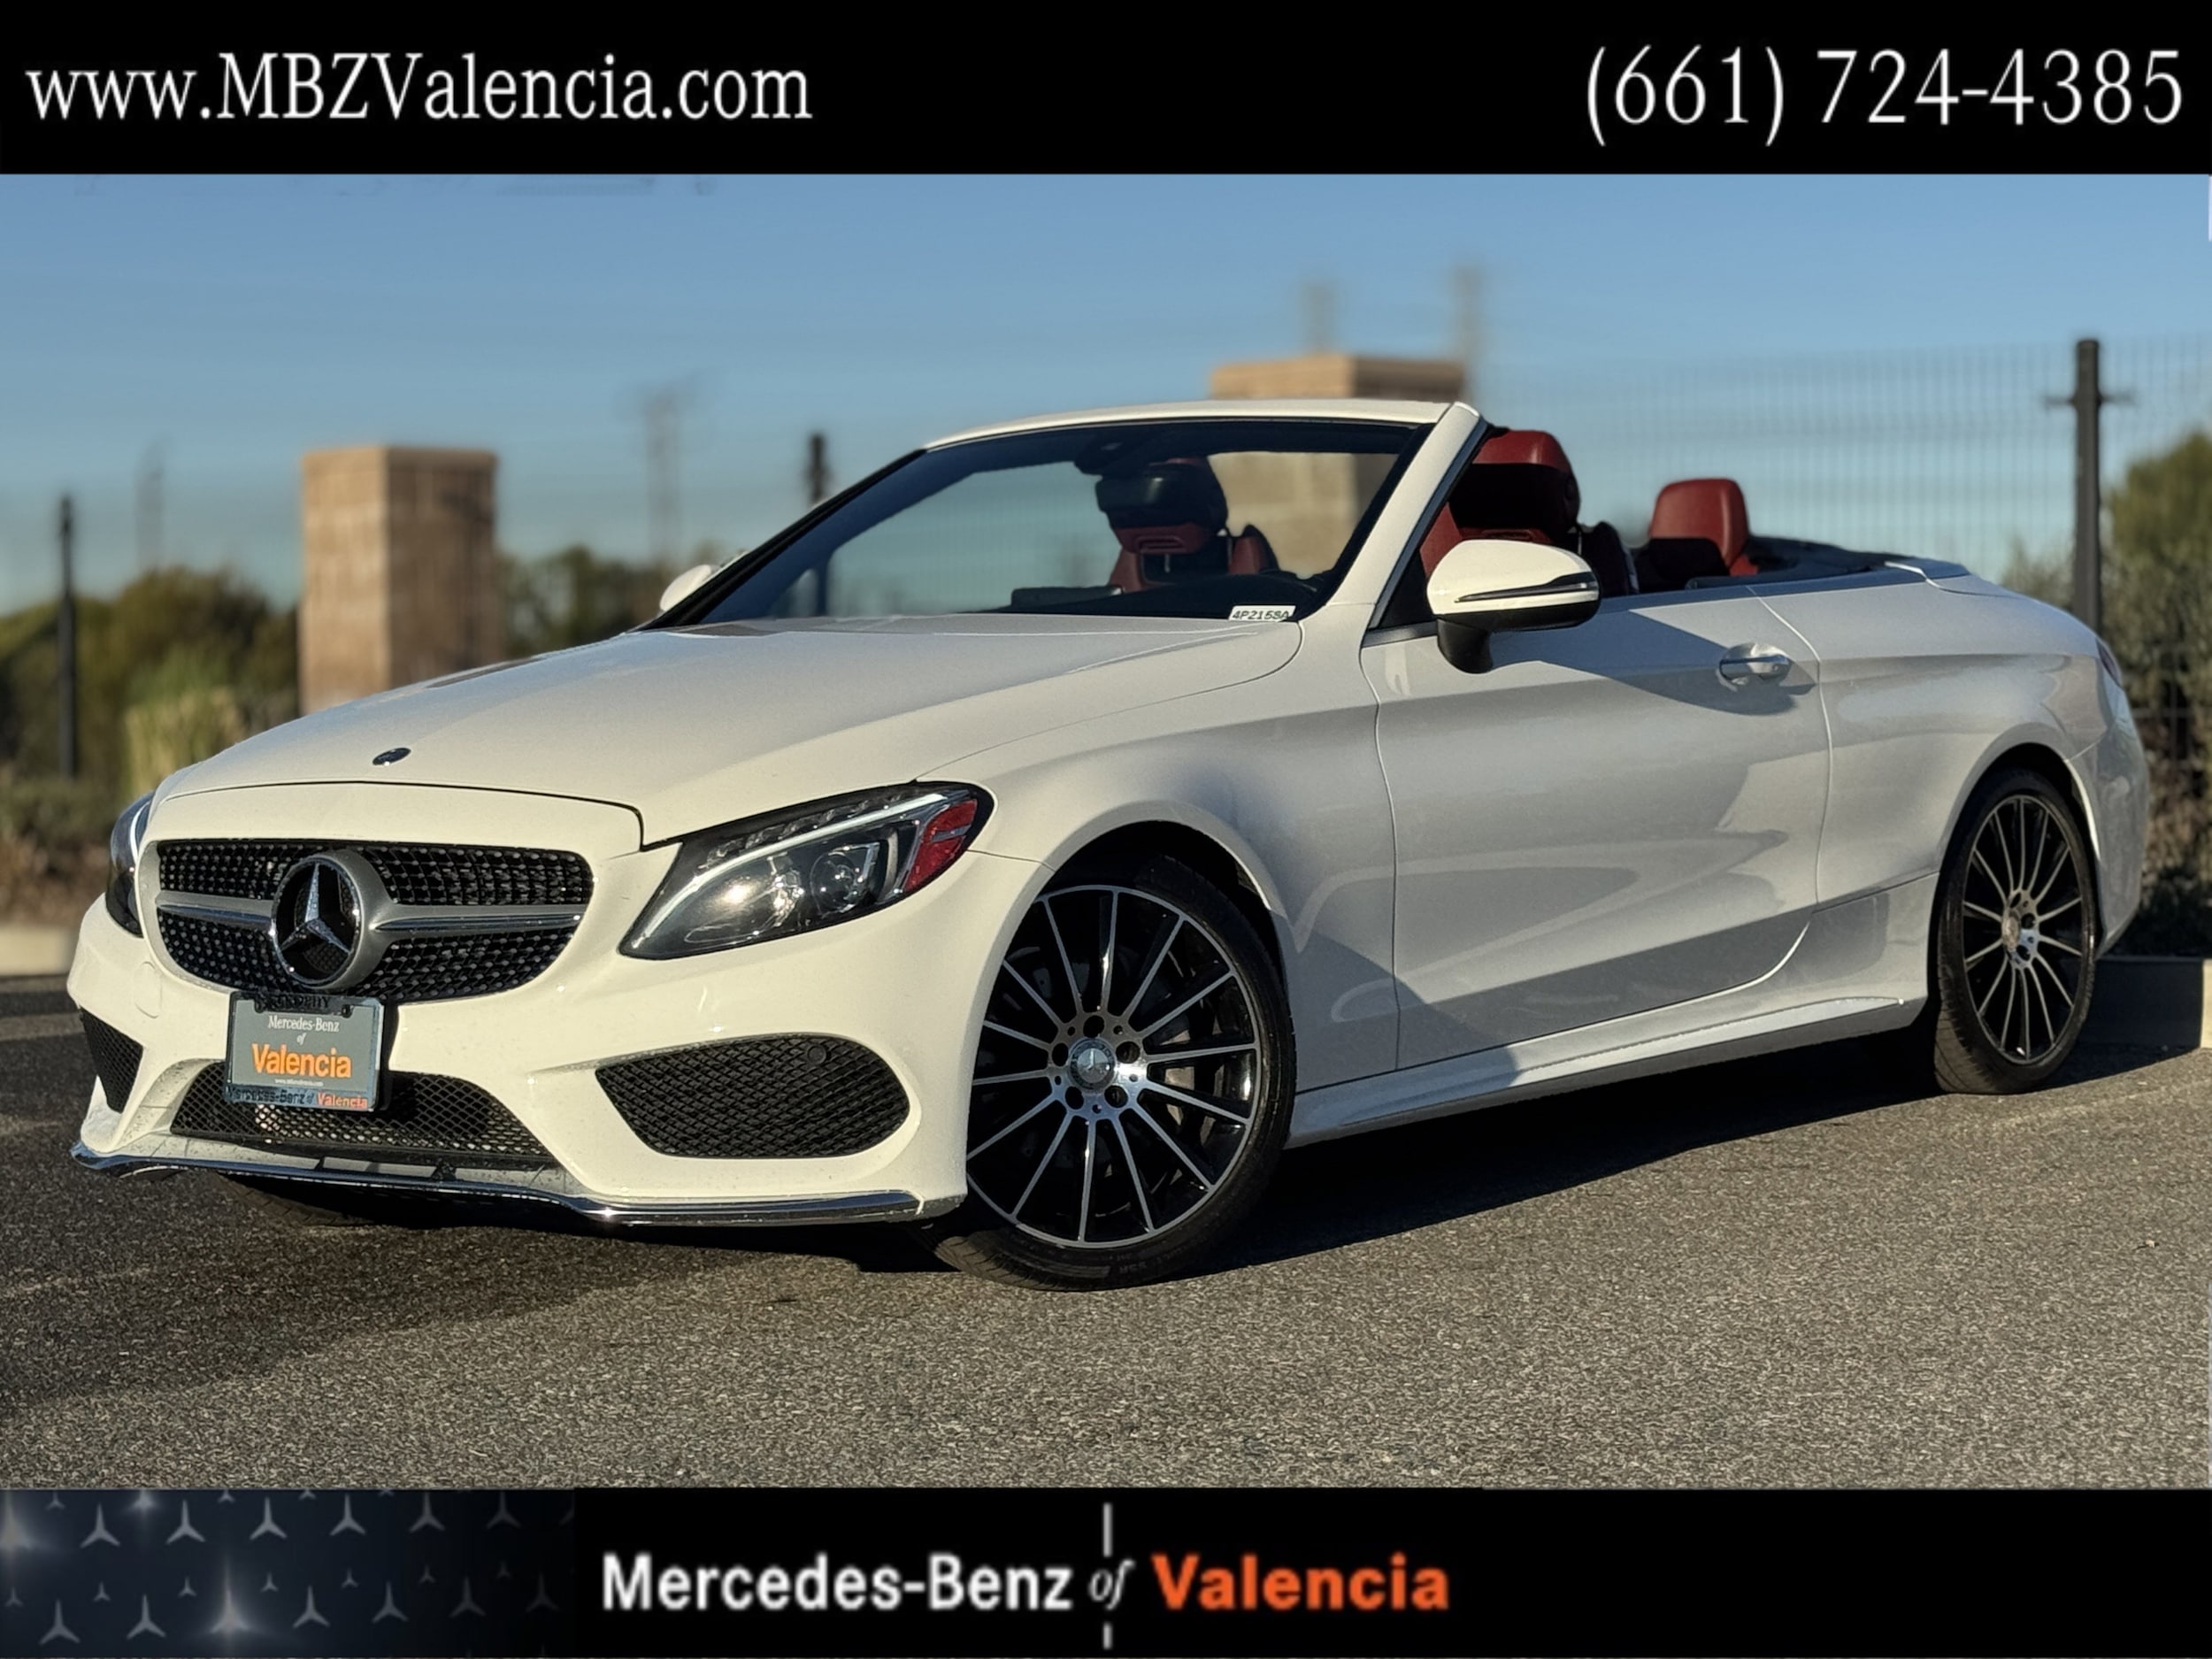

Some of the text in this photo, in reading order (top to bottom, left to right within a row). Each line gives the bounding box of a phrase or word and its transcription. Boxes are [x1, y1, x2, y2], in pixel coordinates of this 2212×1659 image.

[268, 1015, 340, 1033] Mercedes-Benz
[296, 1033, 306, 1045] of
[251, 1043, 352, 1078] Valencia
[317, 1092, 368, 1110] Valencia
